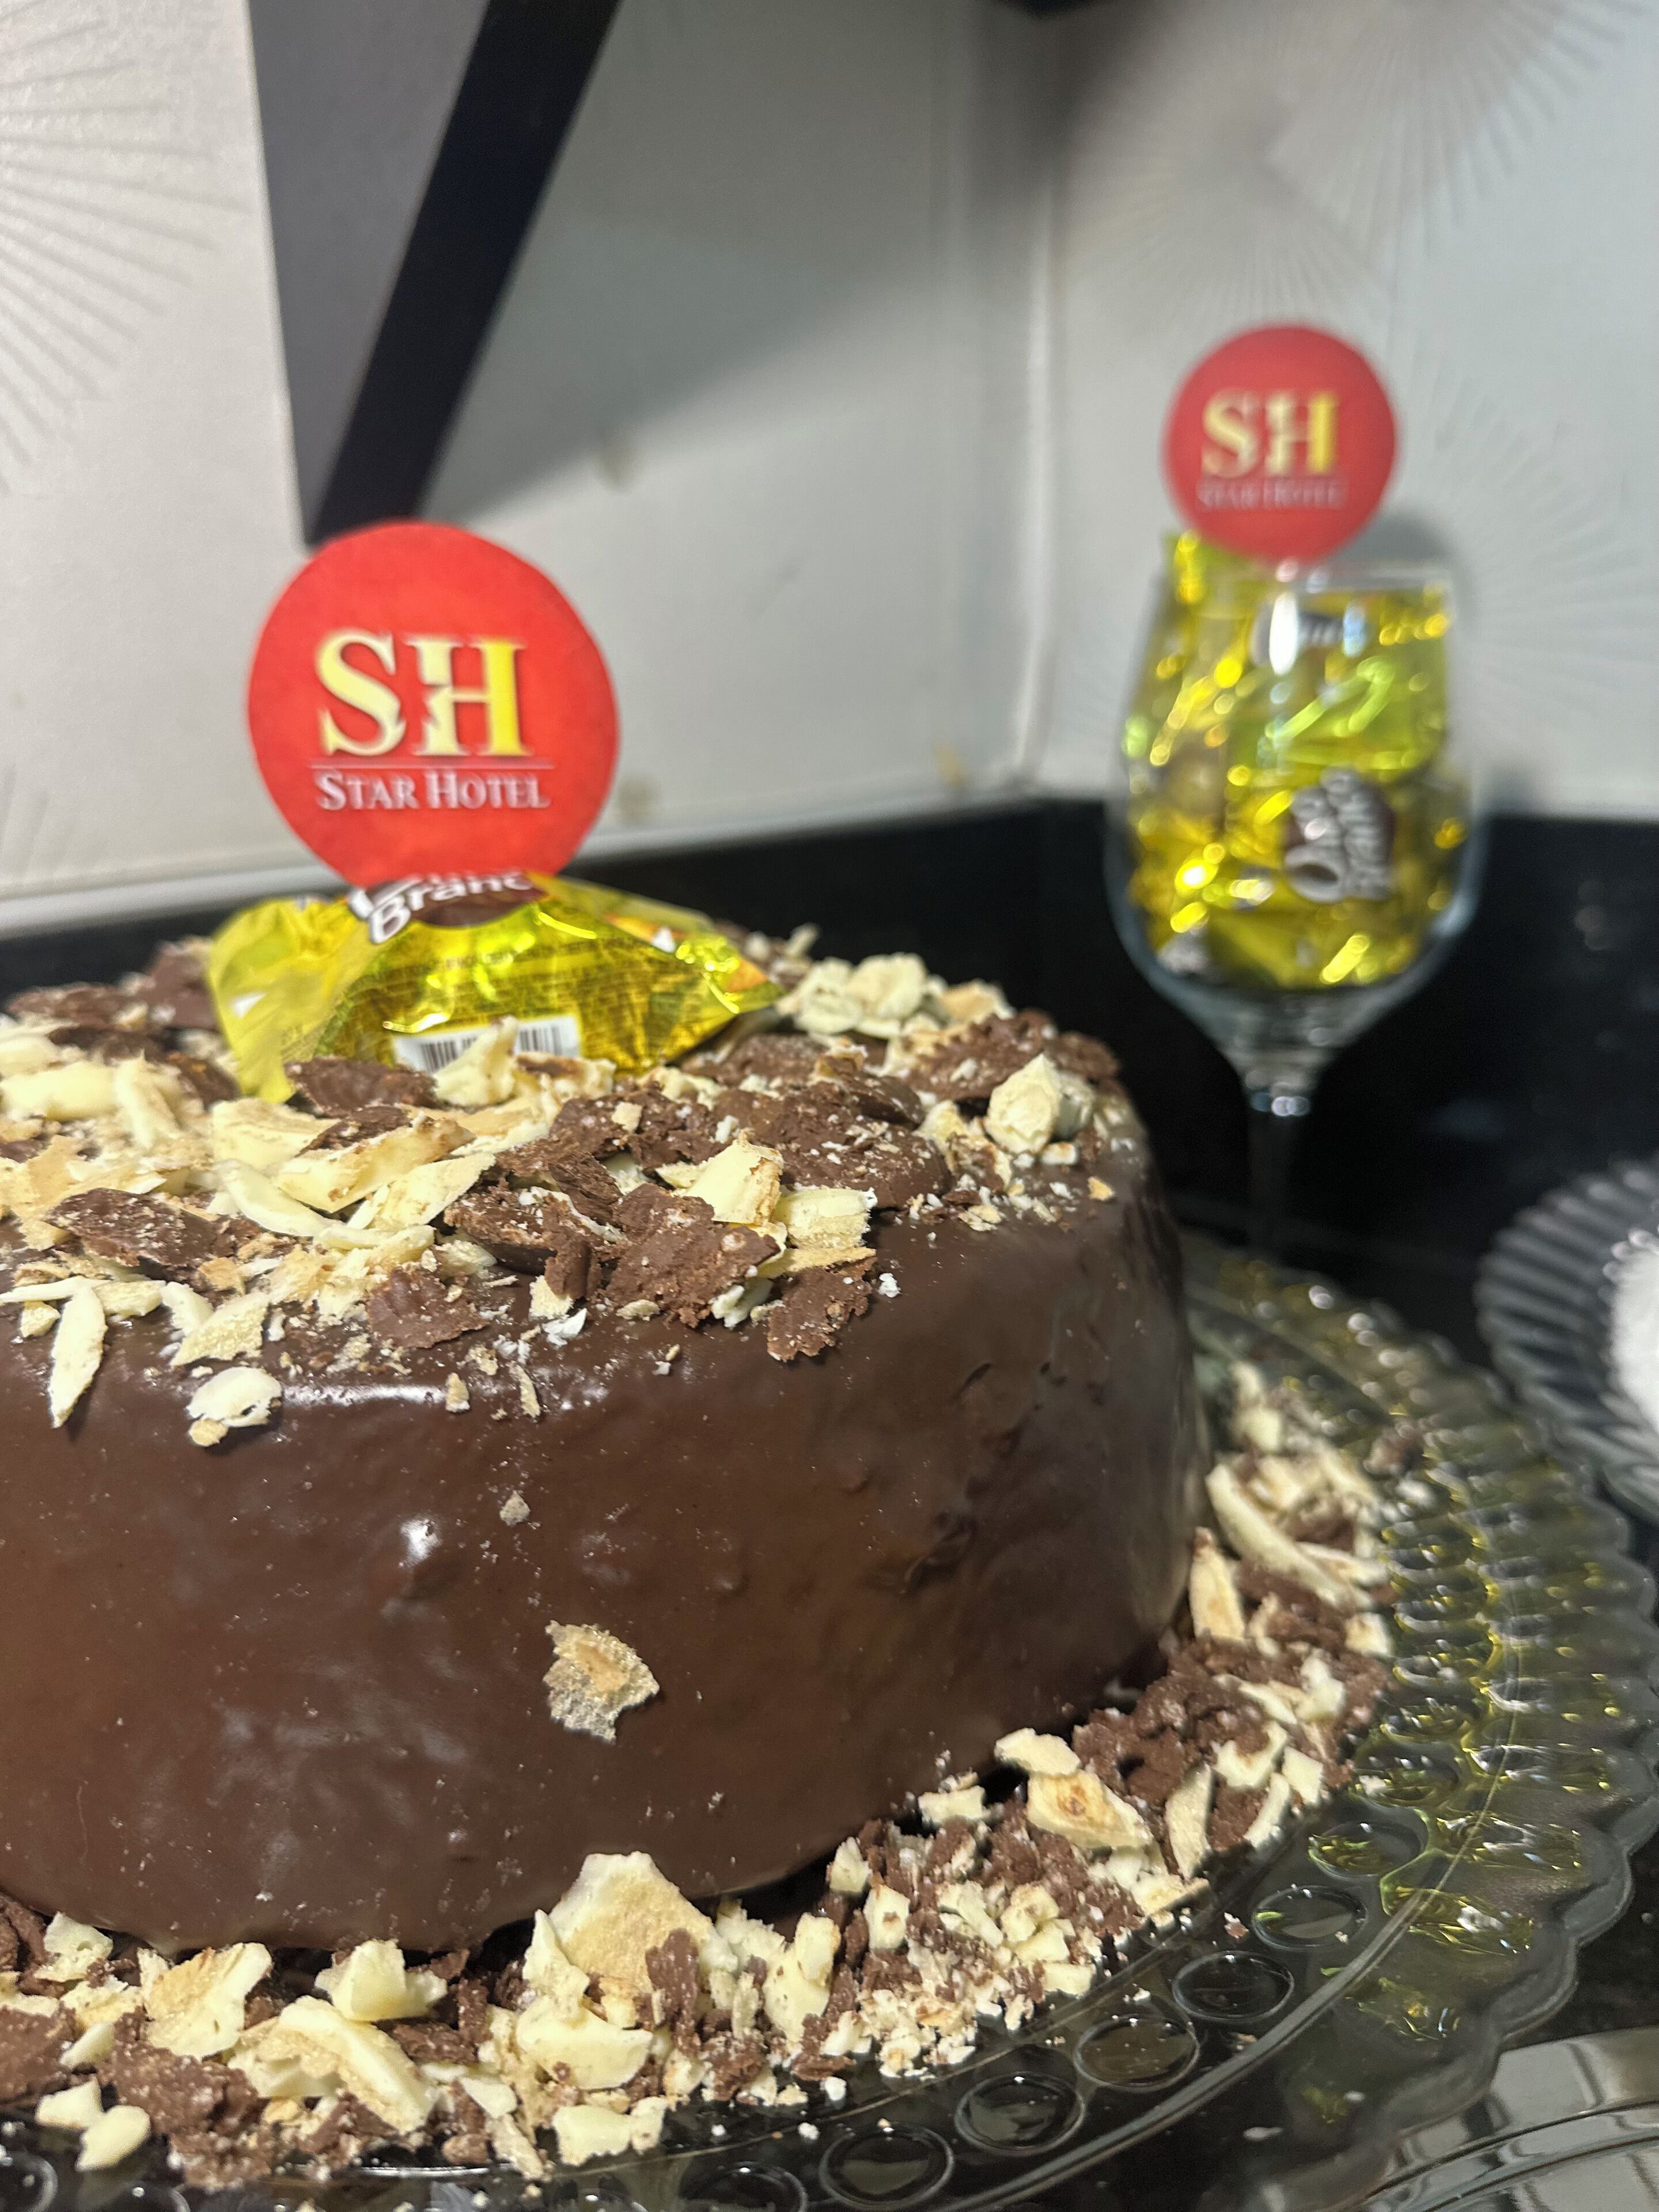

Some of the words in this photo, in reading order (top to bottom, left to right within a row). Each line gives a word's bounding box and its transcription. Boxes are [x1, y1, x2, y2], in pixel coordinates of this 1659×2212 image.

[1202, 391, 1340, 477] SH
[316, 630, 531, 757] SH
[317, 771, 419, 810] STAR
[425, 771, 550, 809] HOTEL
